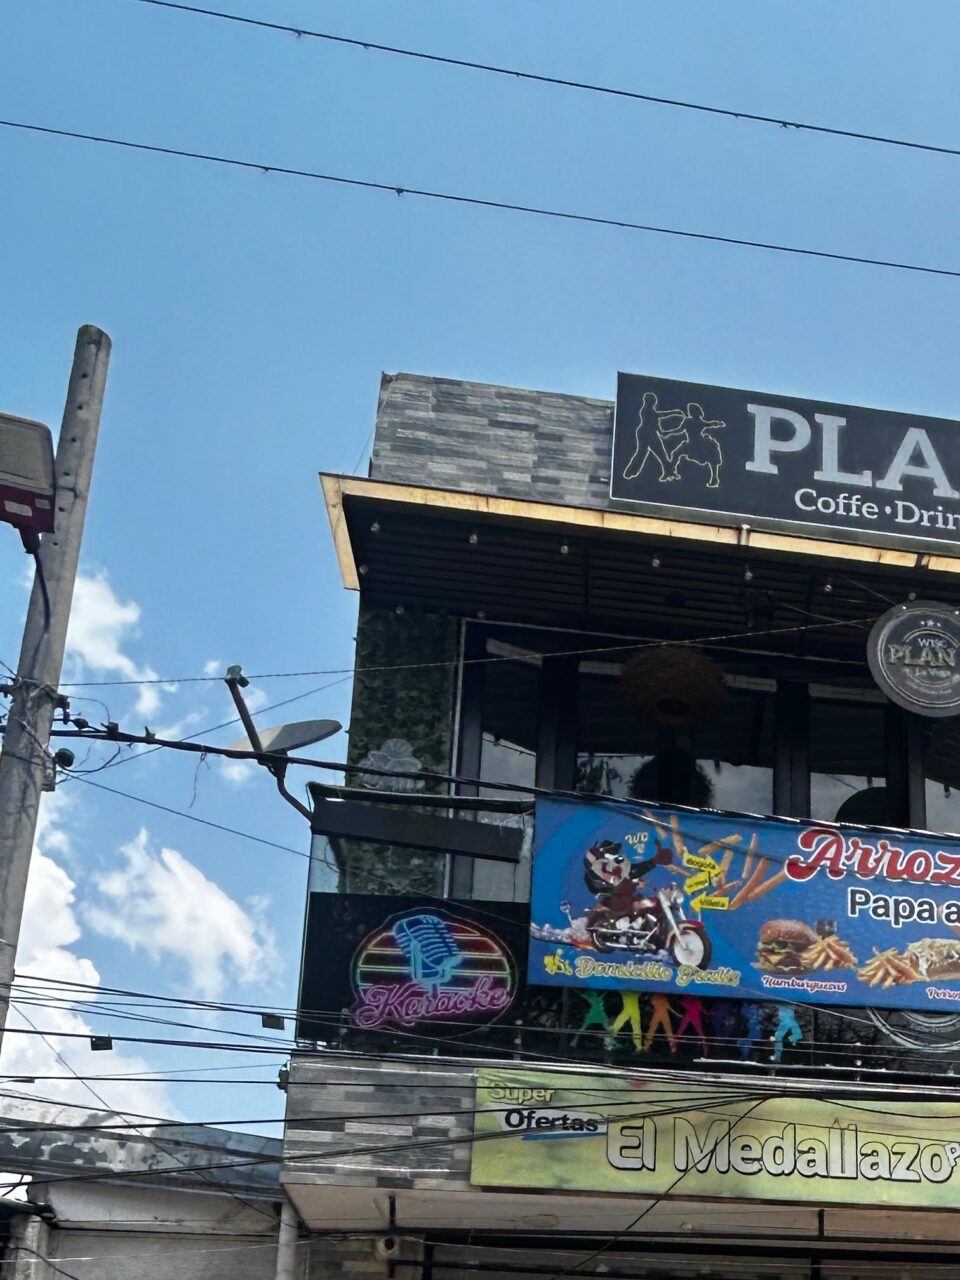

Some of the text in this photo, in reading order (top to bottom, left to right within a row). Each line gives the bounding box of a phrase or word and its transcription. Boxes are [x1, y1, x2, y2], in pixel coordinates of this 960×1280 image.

[794, 488, 879, 519] Coffe
[888, 644, 956, 667] PLAN
[848, 887, 937, 928] Papa
[354, 975, 512, 1030] Karaoke
[489, 1082, 556, 1103] Super
[505, 1110, 600, 1132] Ofertas
[606, 1114, 657, 1172] El
[673, 1116, 955, 1183] Medallazo
